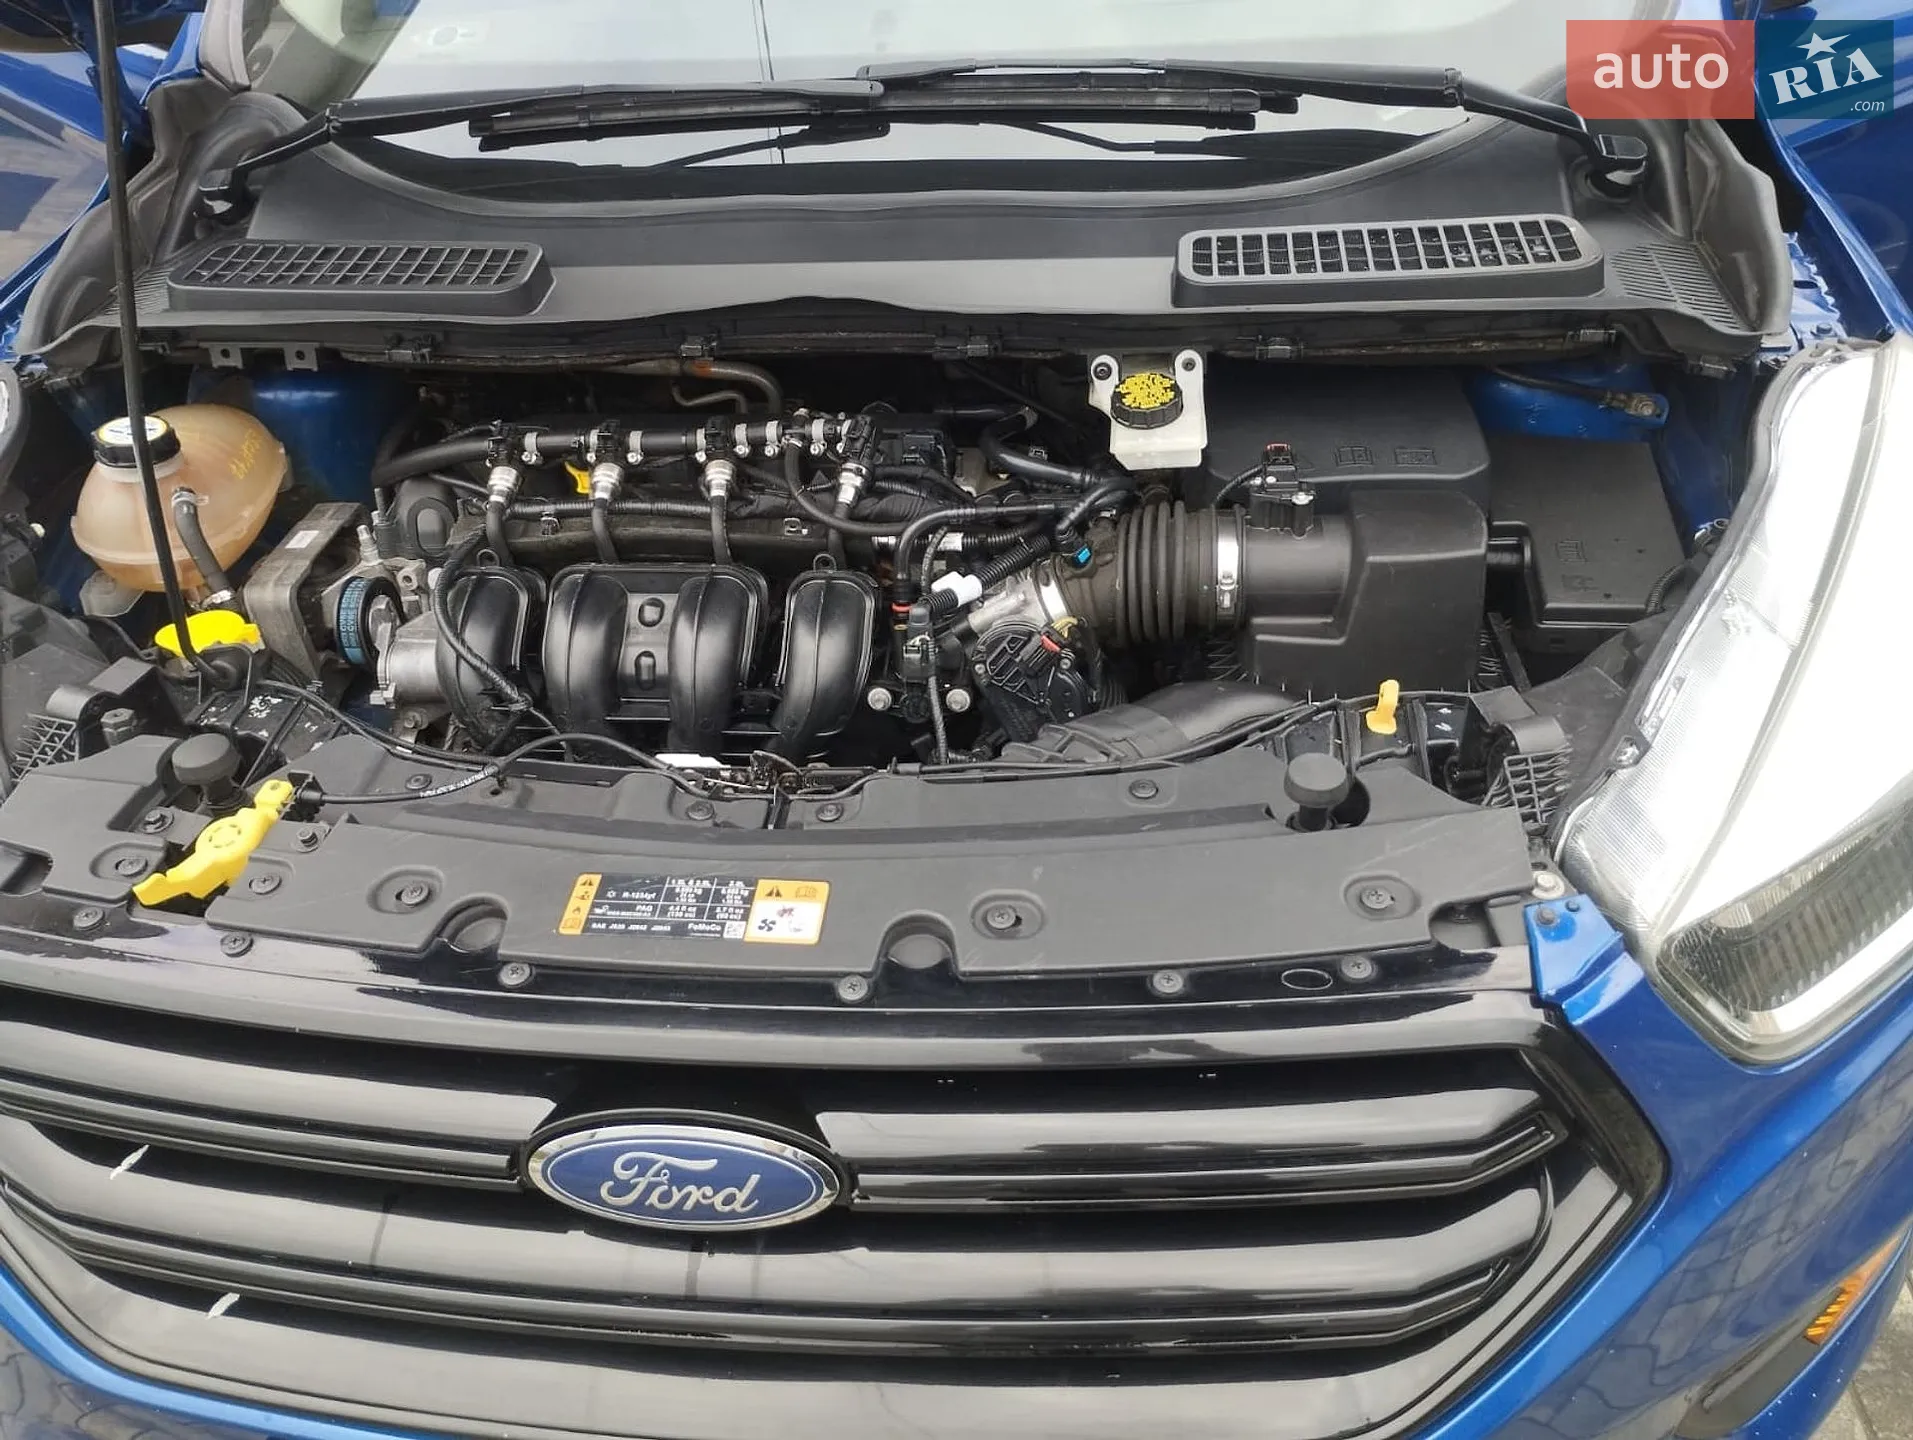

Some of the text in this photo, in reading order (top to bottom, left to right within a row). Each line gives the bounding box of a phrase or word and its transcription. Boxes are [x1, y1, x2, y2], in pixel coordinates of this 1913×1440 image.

[622, 891, 657, 900] R-1234yf
[687, 923, 722, 932] FoMoCo
[600, 1151, 762, 1214] Ford
